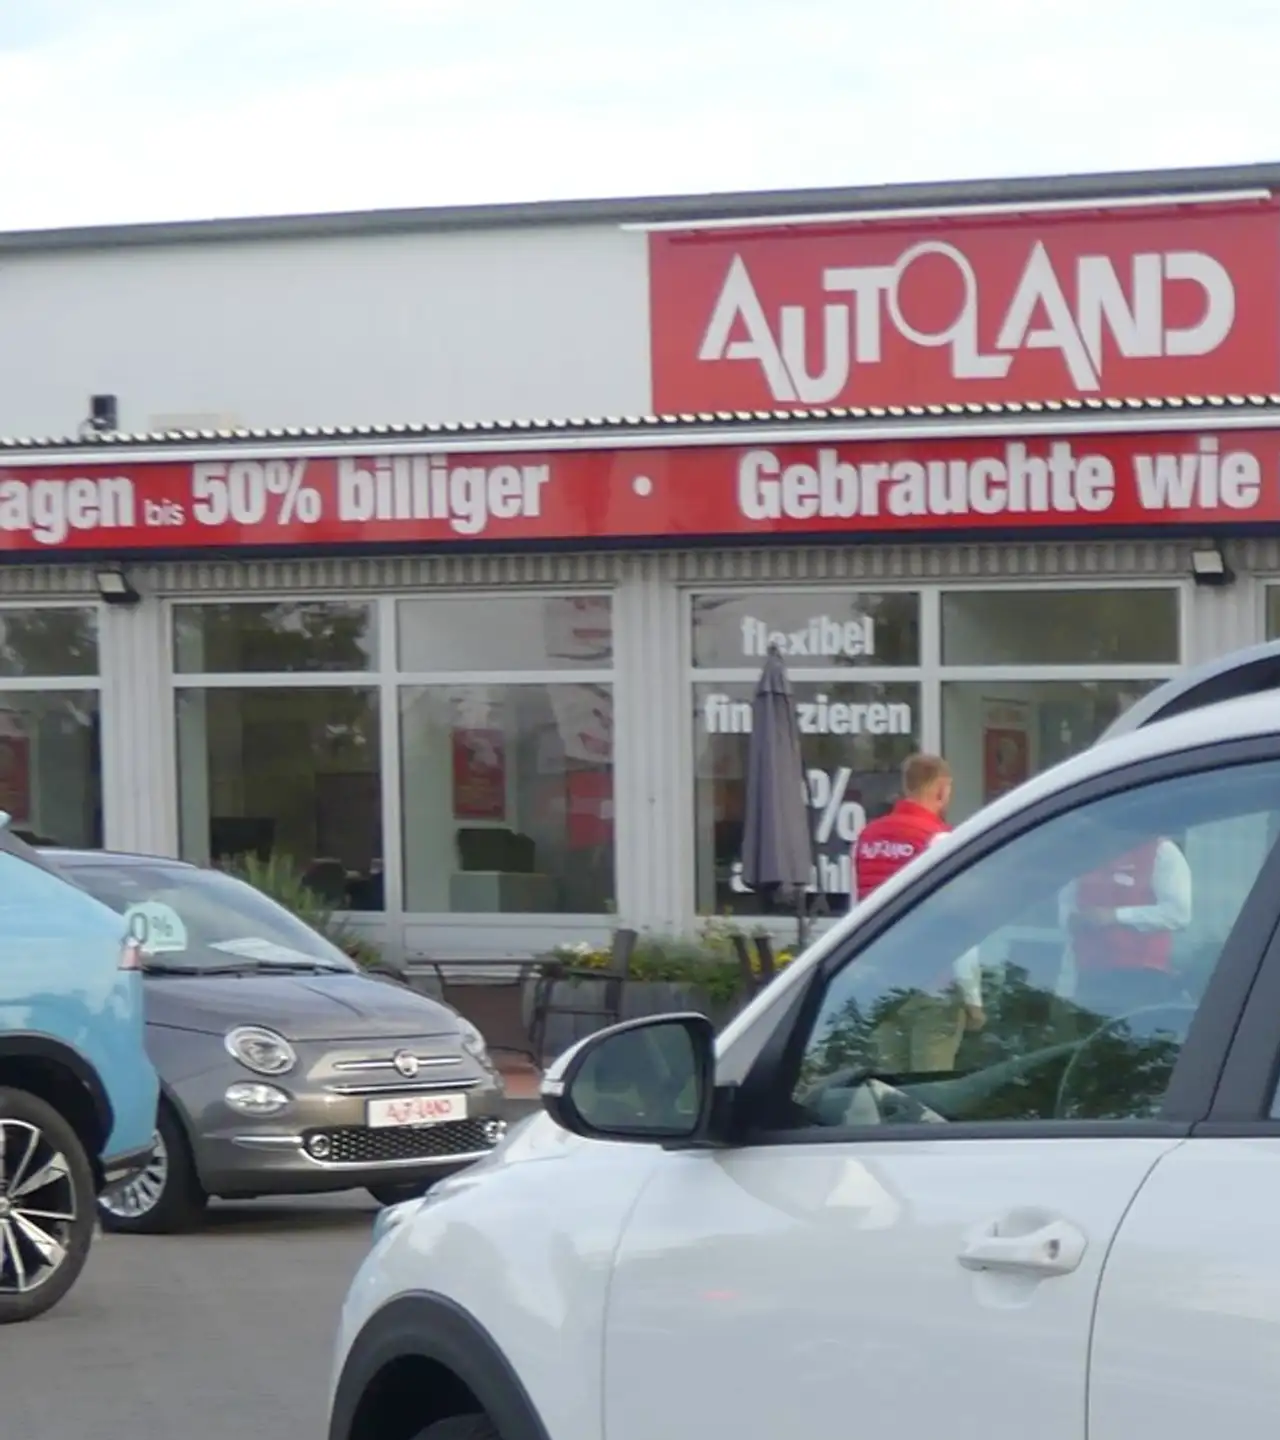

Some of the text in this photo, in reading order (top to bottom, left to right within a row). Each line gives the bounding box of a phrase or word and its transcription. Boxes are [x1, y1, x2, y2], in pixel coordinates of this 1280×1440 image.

[699, 241, 1235, 403] AUTOLAND
[144, 498, 186, 526] bis
[192, 459, 322, 526] 50%
[338, 454, 550, 535] billiger
[738, 442, 1114, 519] Gebrauchte
[1134, 437, 1261, 510] wie
[741, 615, 875, 656] flexibel
[704, 694, 912, 734] finzieren
